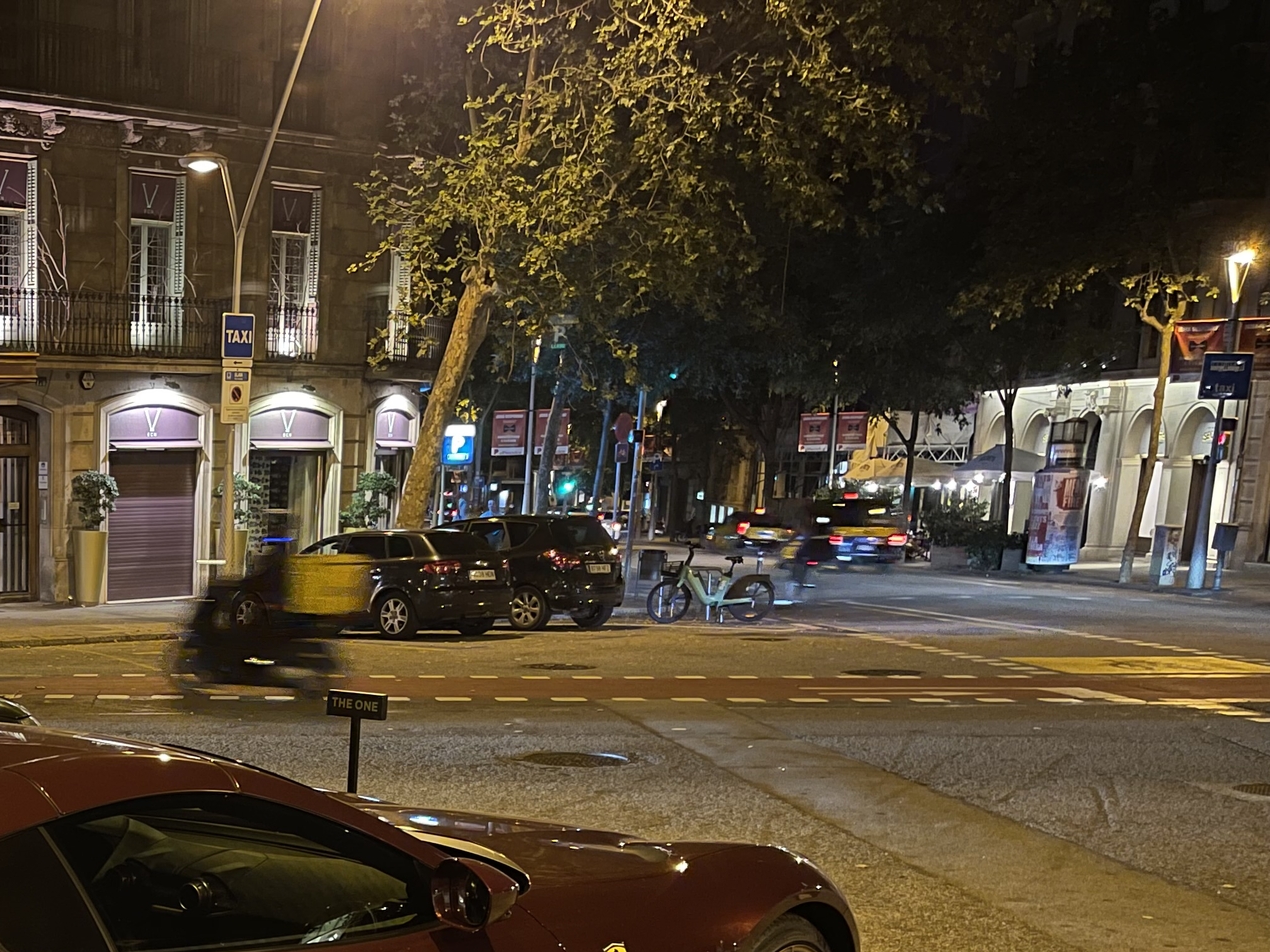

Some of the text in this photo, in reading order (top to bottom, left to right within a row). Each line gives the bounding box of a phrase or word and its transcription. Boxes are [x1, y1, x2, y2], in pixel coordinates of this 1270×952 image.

[142, 183, 159, 208] V
[282, 197, 297, 221] V
[226, 329, 252, 344] TAXI
[1214, 383, 1236, 393] taxi
[144, 407, 163, 432] V
[280, 409, 297, 432] V
[387, 411, 396, 433] V
[332, 696, 379, 712] THE ONE
